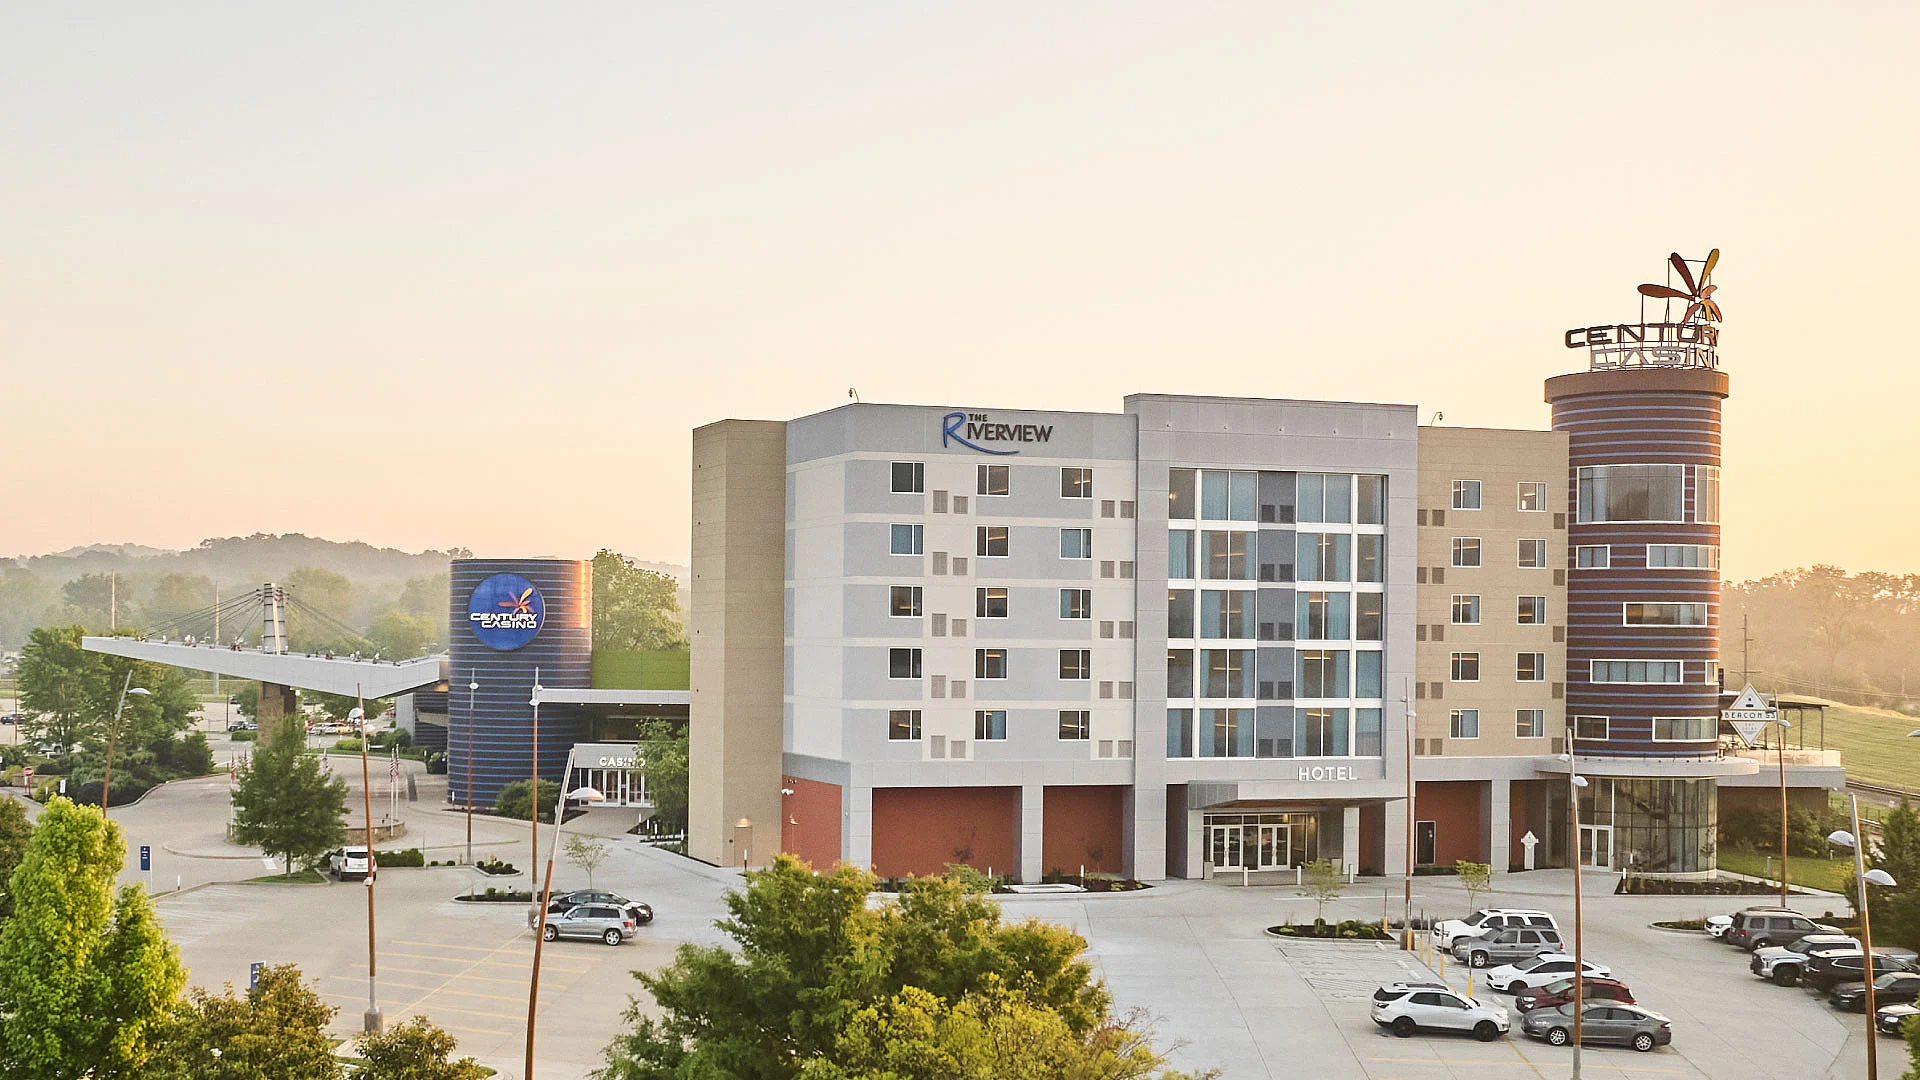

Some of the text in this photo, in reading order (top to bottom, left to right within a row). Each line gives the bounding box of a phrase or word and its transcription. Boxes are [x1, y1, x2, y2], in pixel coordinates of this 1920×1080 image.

[1591, 347, 1719, 369] CASIN
[968, 413, 988, 422] THE
[943, 412, 1054, 455] RIVERVIEW
[470, 613, 538, 621] CENTURY
[481, 620, 537, 629] CASINO
[1724, 711, 1762, 719] BEACON
[1298, 766, 1358, 781] HOTEL
